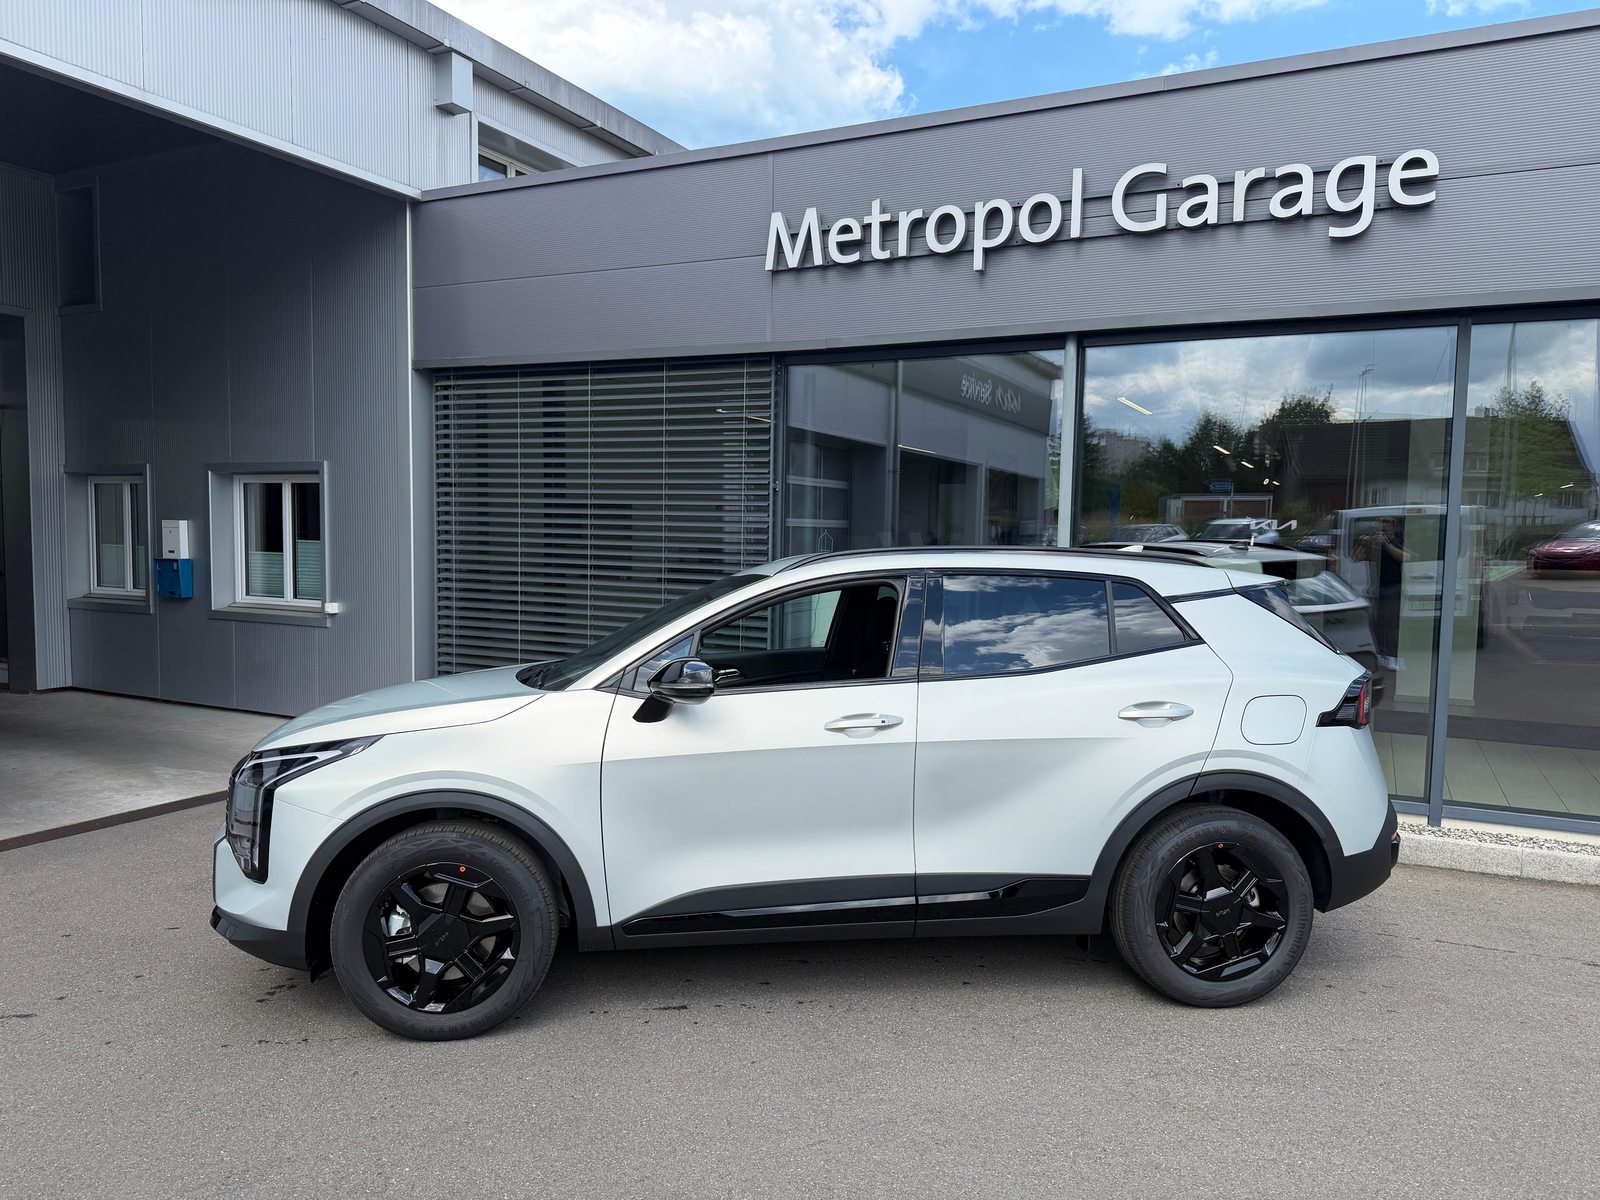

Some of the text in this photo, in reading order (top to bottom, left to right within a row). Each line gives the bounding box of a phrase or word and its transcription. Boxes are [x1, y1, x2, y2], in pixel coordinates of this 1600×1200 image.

[765, 148, 1439, 272] Metropol Garage
[1250, 519, 1297, 530] KIA
[1288, 894, 1309, 960] Continental
